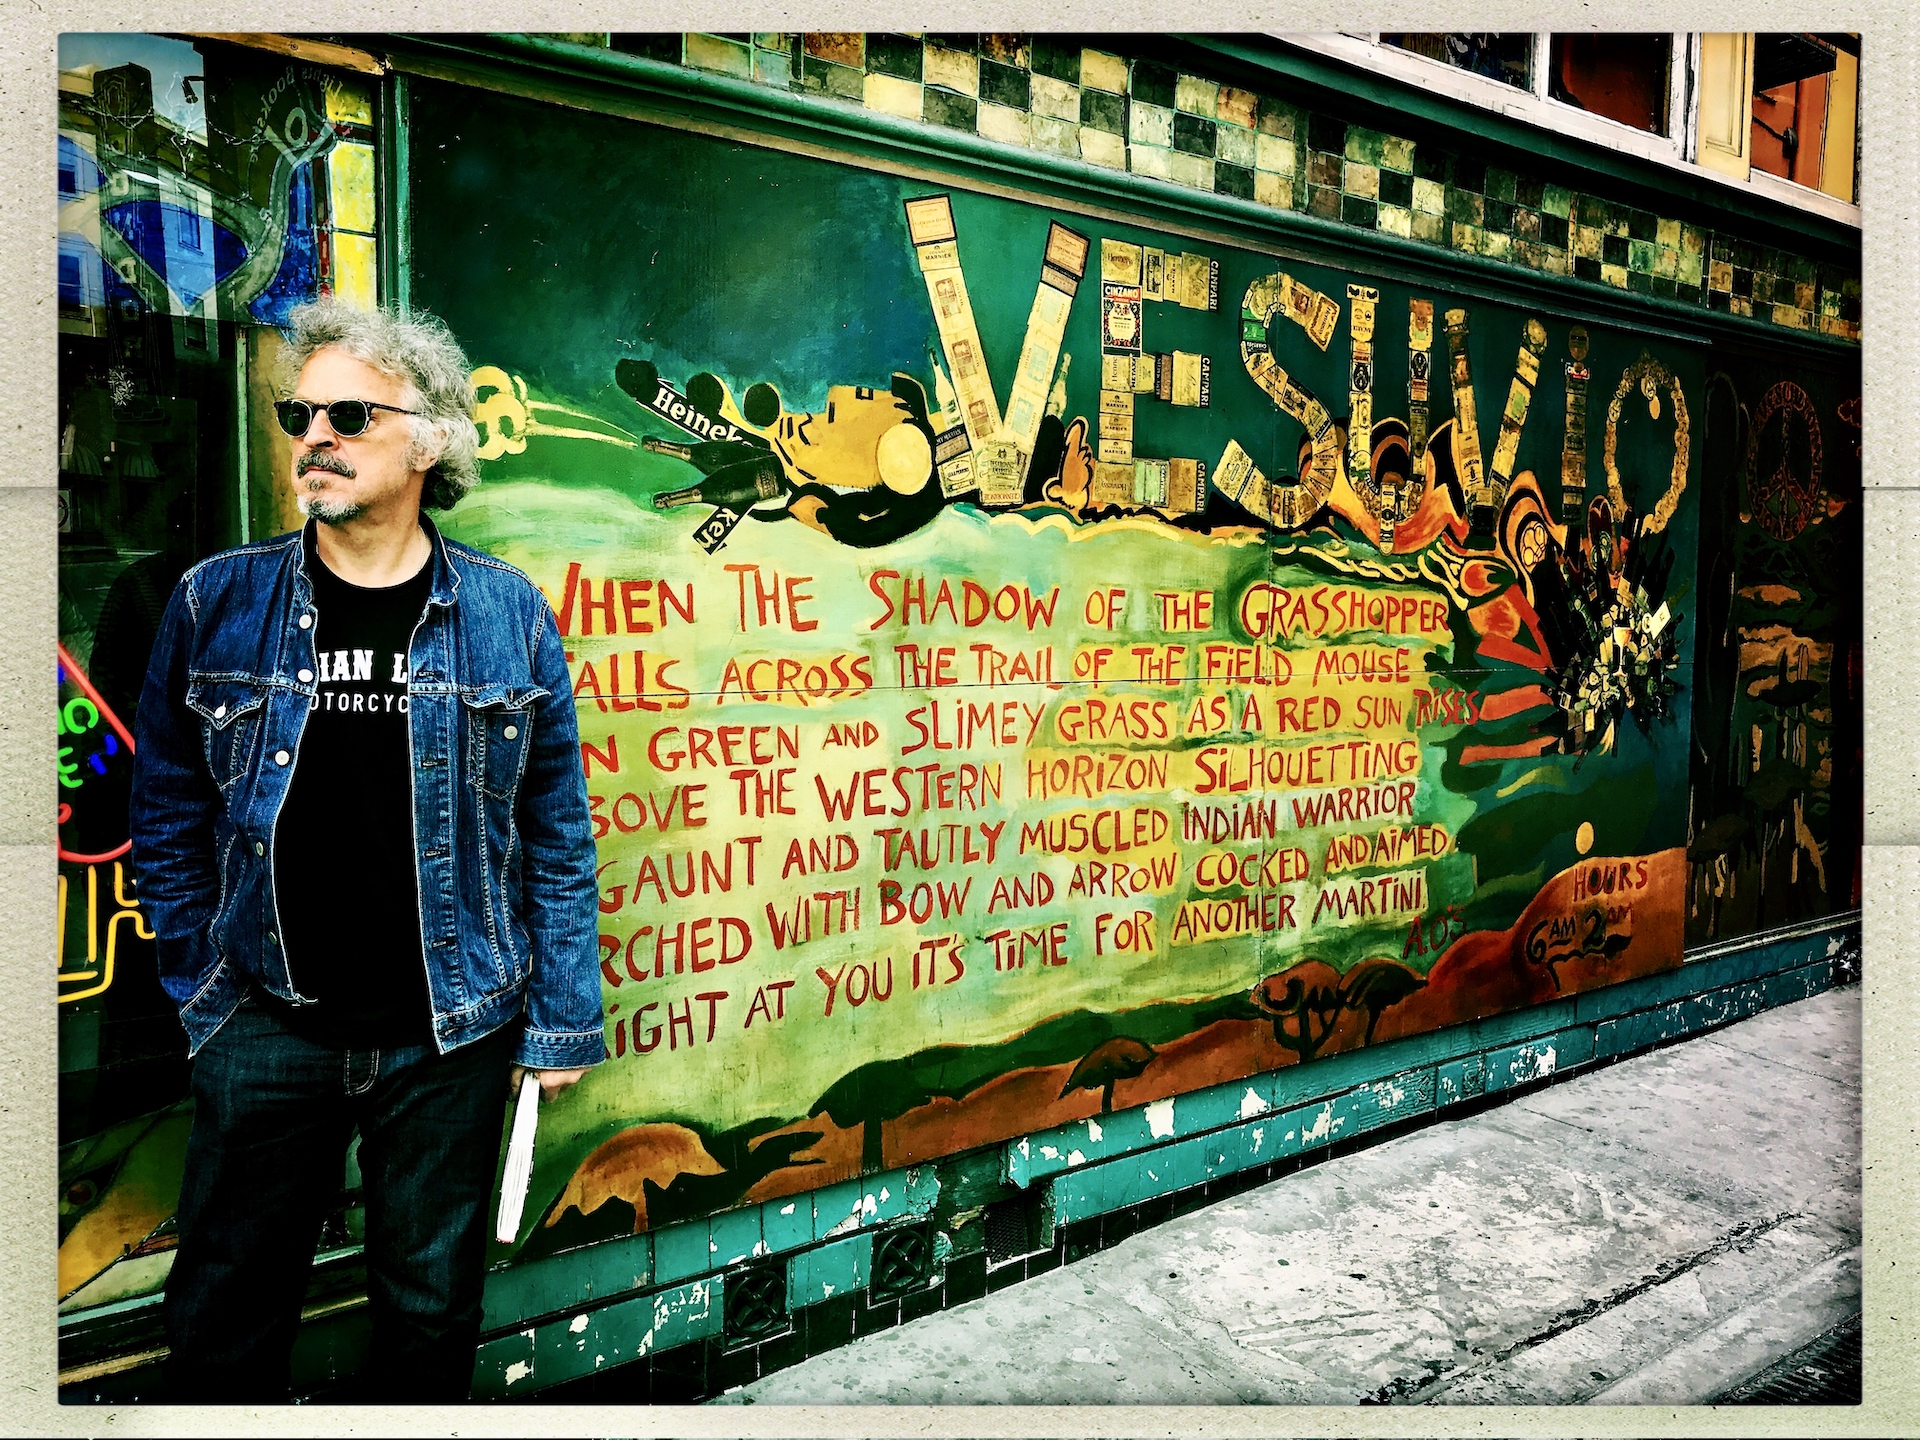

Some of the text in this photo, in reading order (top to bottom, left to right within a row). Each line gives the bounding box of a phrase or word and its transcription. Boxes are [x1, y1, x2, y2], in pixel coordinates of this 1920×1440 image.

[1105, 286, 1139, 298] CINZANO
[1210, 260, 1219, 310] CAMPARI
[903, 195, 1690, 557] VESUVIO
[1201, 357, 1211, 407] CAMPARI
[1196, 462, 1206, 512] CAMPARI
[724, 563, 819, 632] THE
[869, 570, 1059, 631] SHADOW
[1085, 589, 1125, 628] OF
[1160, 590, 1213, 631] THE
[1241, 583, 1449, 639] GRASSHOPPER
[565, 651, 690, 713] ALLS
[717, 654, 873, 707] ACROSS
[893, 643, 958, 690] THE
[973, 643, 1063, 690] TRAIL
[1074, 649, 1114, 689] OF
[1131, 646, 1186, 686] THE
[1313, 648, 1411, 687] MOUSE
[647, 725, 800, 773] GREEN
[822, 720, 880, 752] AND
[1058, 700, 1169, 743] GRASS
[1187, 696, 1228, 733] AS
[1240, 693, 1262, 732] A
[1276, 696, 1340, 732] RED
[1357, 695, 1402, 732] SUN
[729, 768, 797, 819] THE
[814, 763, 1003, 823] WESTERN
[595, 836, 762, 914] GAUNT
[781, 835, 860, 880] AND
[873, 820, 1006, 872] TAUTLY
[1018, 807, 1169, 857] MUSCLED
[765, 888, 861, 951] WITH
[877, 876, 972, 926] BOW
[987, 872, 1055, 915] AND
[1068, 852, 1178, 899] ARROW
[1195, 847, 1309, 888] COCKED
[1325, 836, 1371, 874] AND
[1573, 860, 1649, 903] HOURS
[744, 980, 795, 1030] AT
[815, 956, 893, 1018] YOU
[912, 931, 965, 991] IT'S
[1095, 911, 1154, 957] FOR
[1172, 893, 1298, 941] ANOTHER
